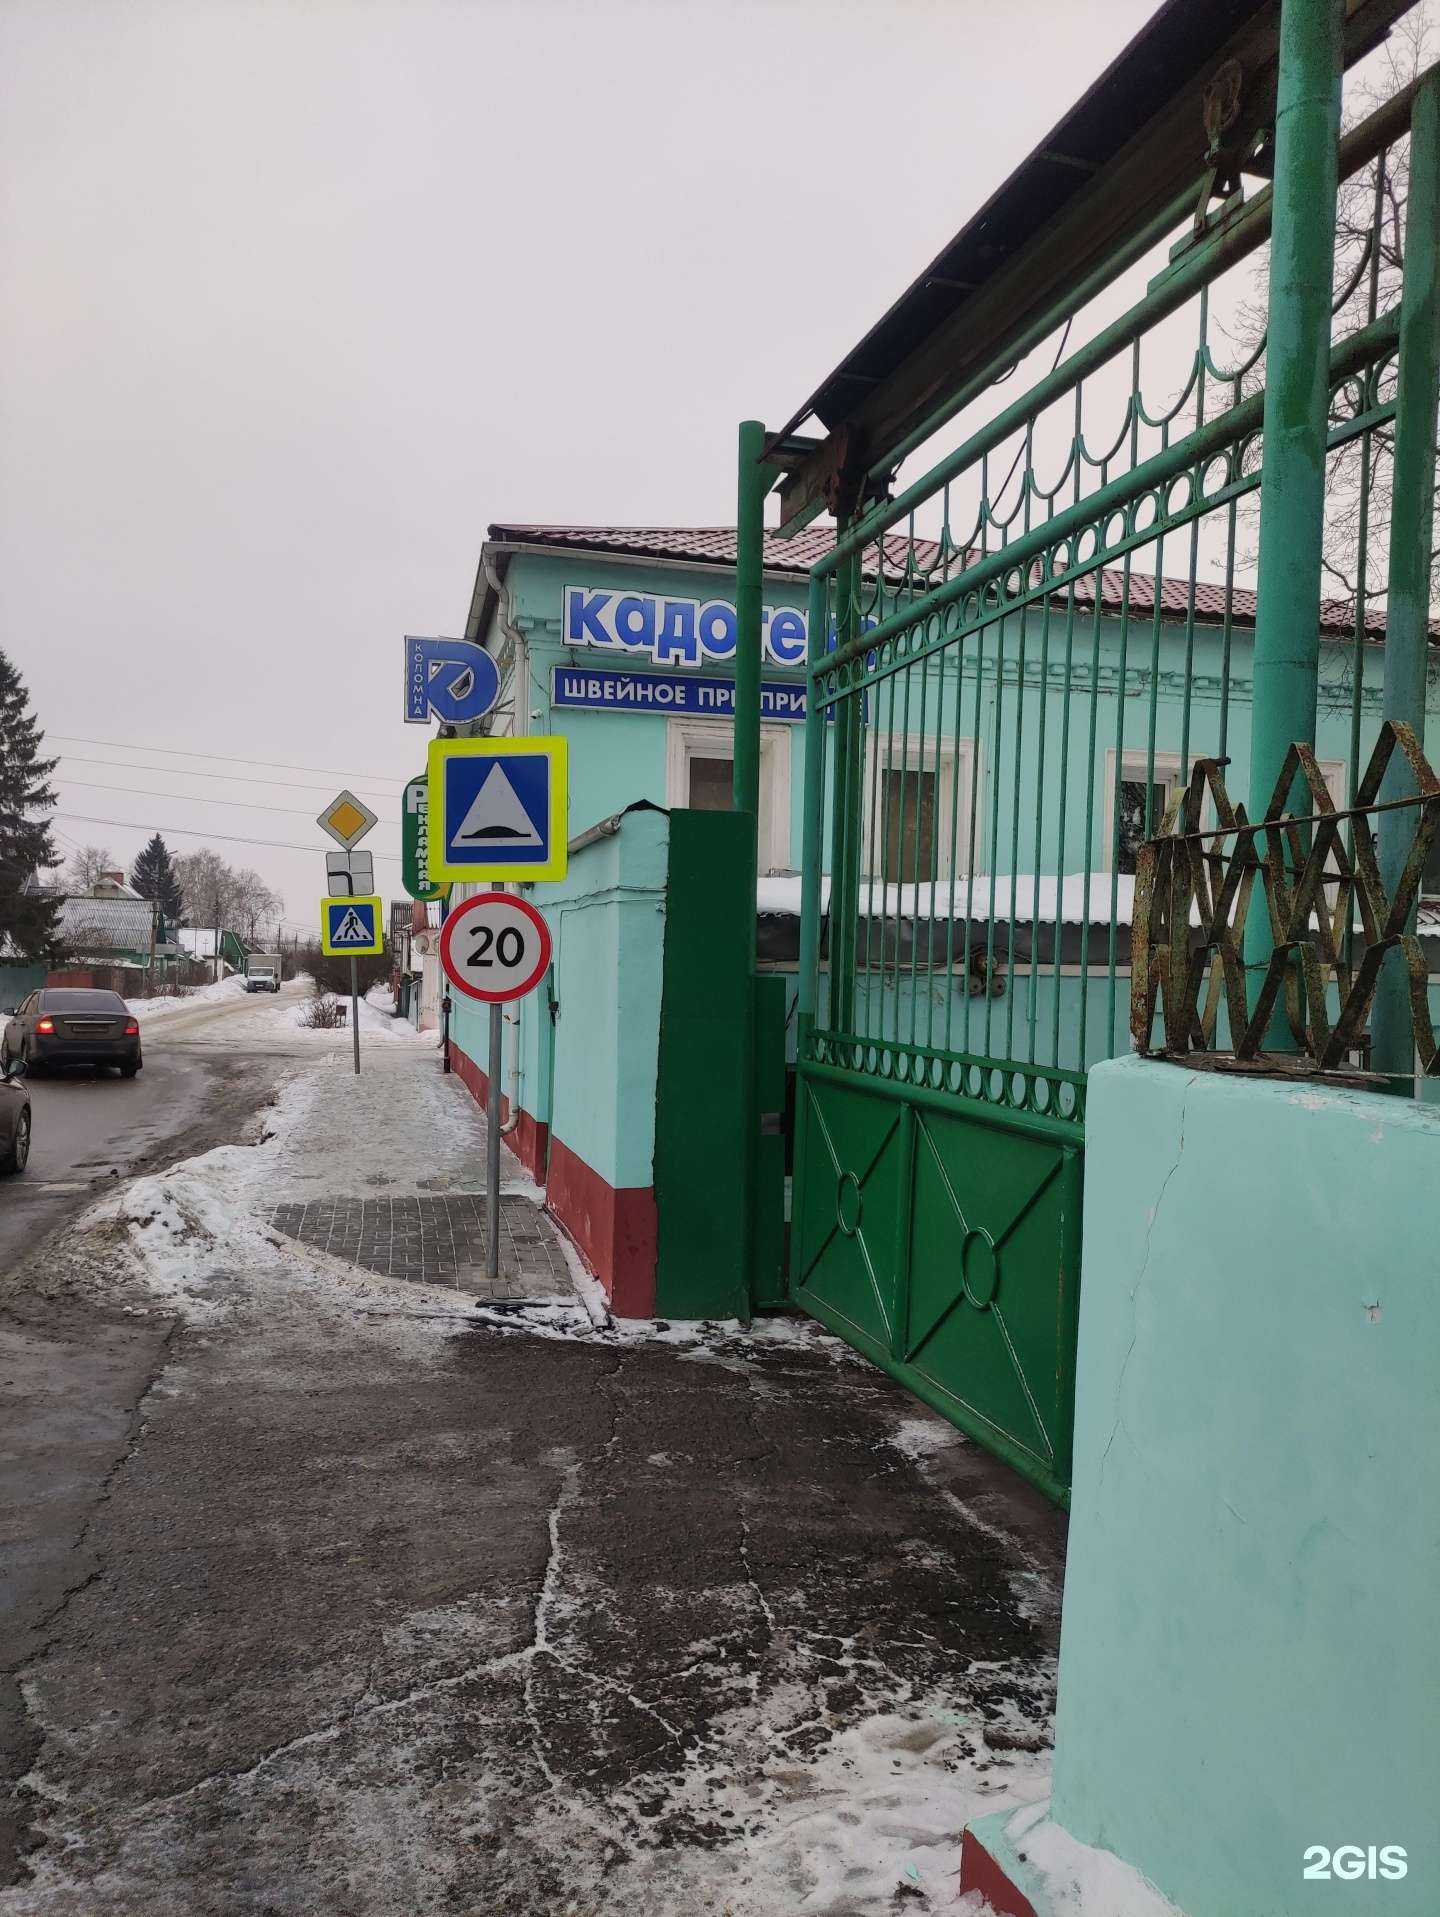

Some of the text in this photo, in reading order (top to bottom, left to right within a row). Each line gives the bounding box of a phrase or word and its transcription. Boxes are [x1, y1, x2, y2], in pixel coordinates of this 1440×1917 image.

[413, 643, 424, 715] КОЛОМНА
[564, 677, 686, 704] ШВЕЙНОЕ
[467, 926, 525, 967] 20
